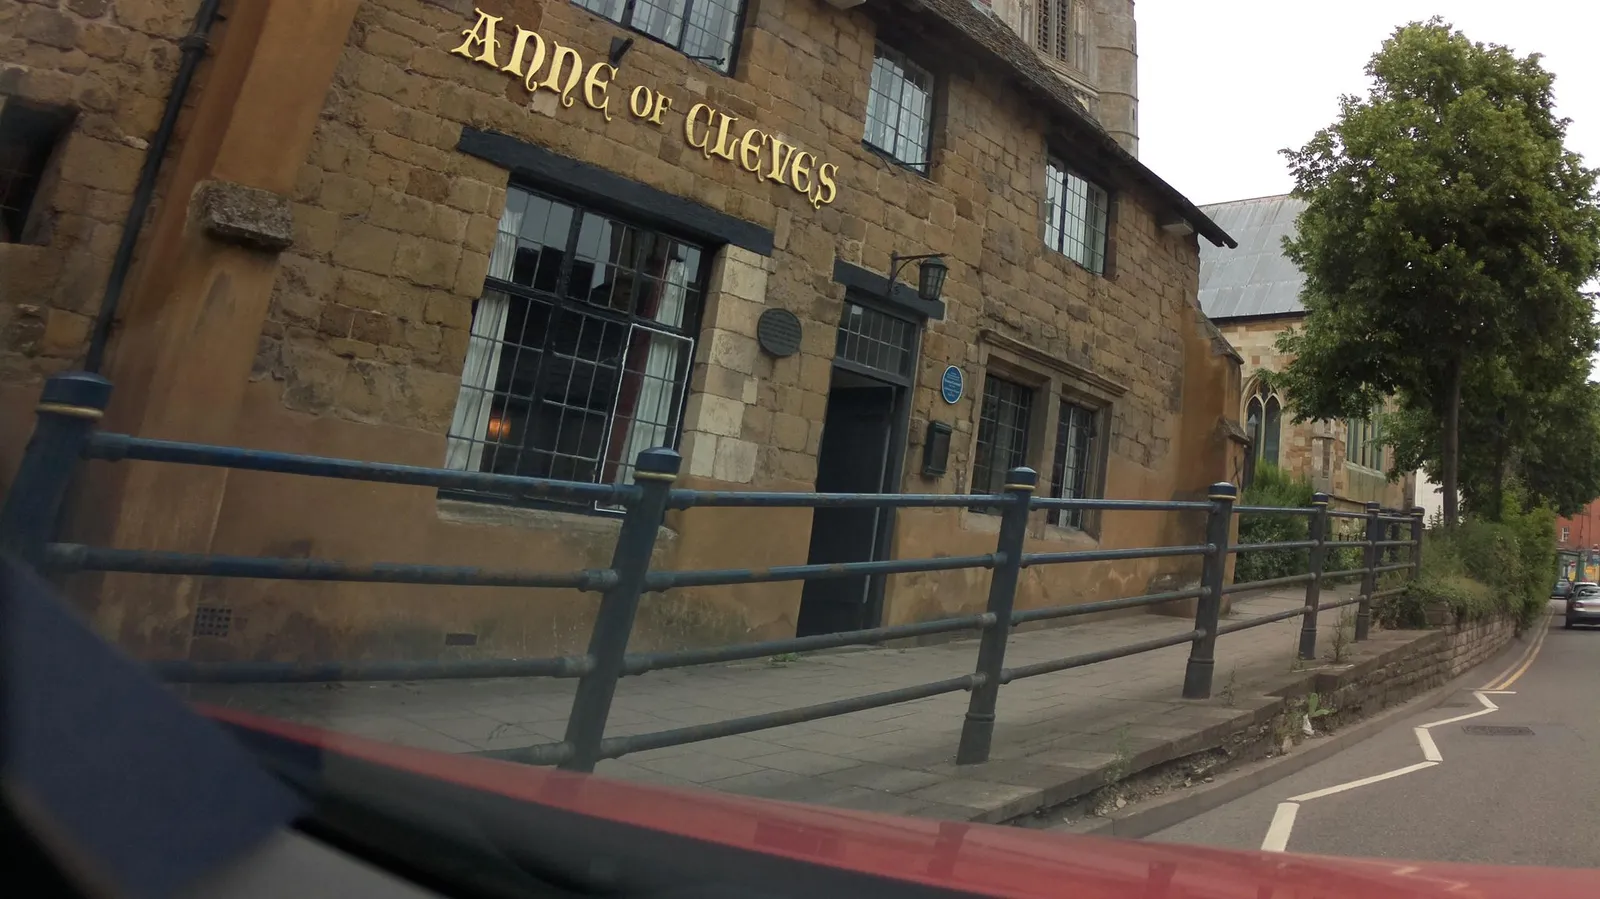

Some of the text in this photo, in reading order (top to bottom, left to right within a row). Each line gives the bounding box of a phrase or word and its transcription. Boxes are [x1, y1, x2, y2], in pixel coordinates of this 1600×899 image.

[450, 7, 840, 209] ANNE OF CLEVES
